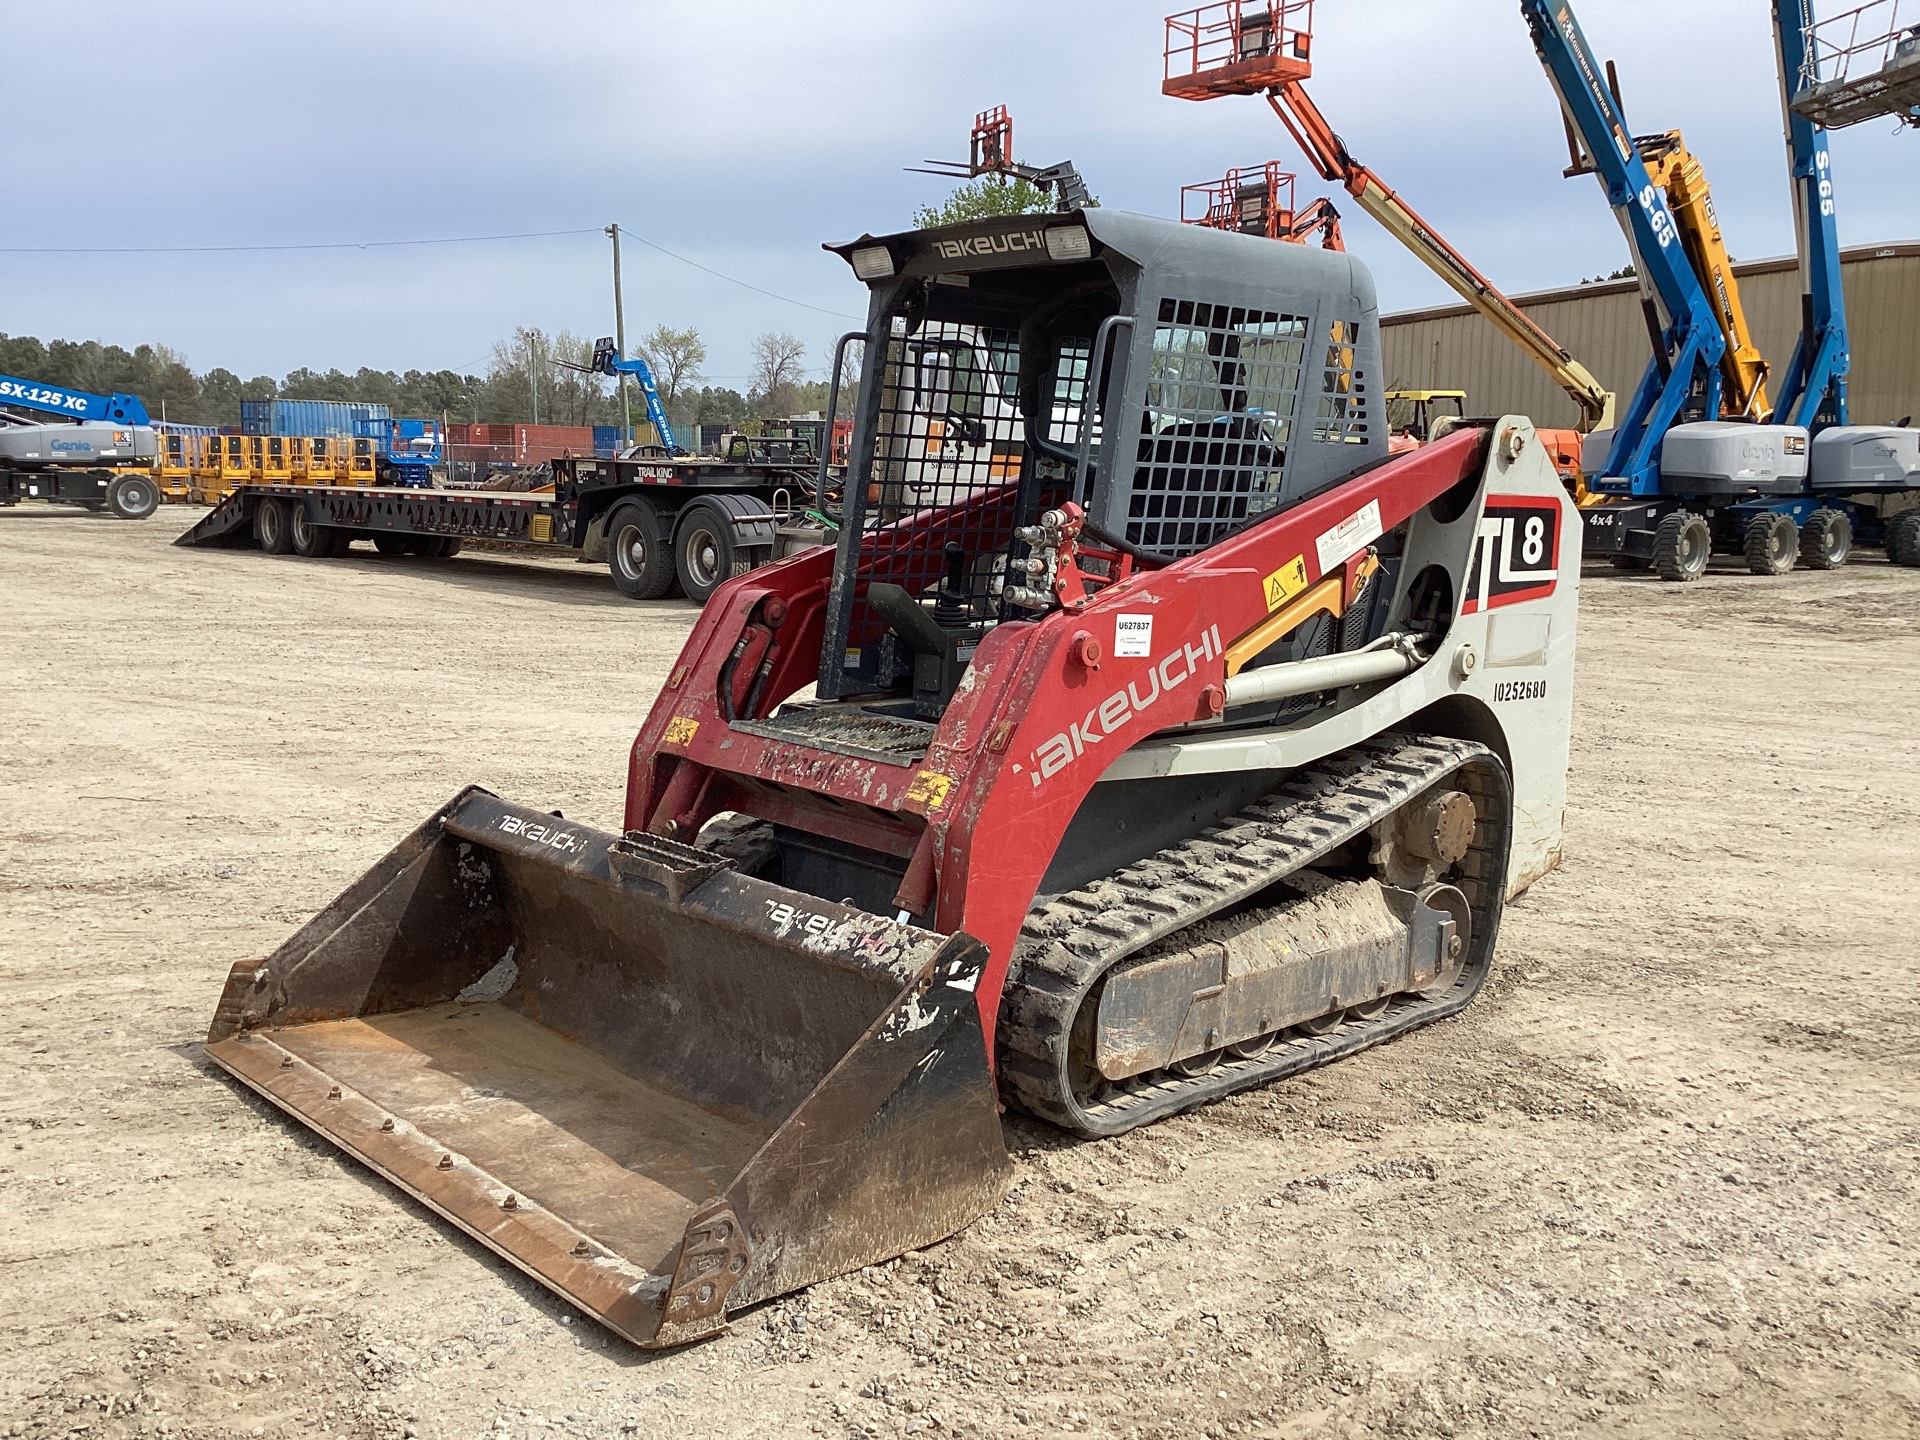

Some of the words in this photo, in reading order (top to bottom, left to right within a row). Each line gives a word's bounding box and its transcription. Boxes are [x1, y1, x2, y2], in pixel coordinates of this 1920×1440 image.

[1569, 32, 1594, 81] EQUIPMENT
[1591, 80, 1611, 118] SERVICES
[1815, 150, 1834, 217] S-65
[1639, 184, 1675, 248] S-65
[931, 230, 1046, 259] TAKEUCHI
[0, 381, 63, 406] SX-125
[63, 395, 88, 411] XC
[50, 438, 92, 452] Genie
[637, 466, 656, 478] TRAIL
[656, 467, 673, 479] KING
[1589, 514, 1613, 526] 4x4
[1118, 621, 1150, 630] U627837
[1493, 680, 1546, 702] 10252680
